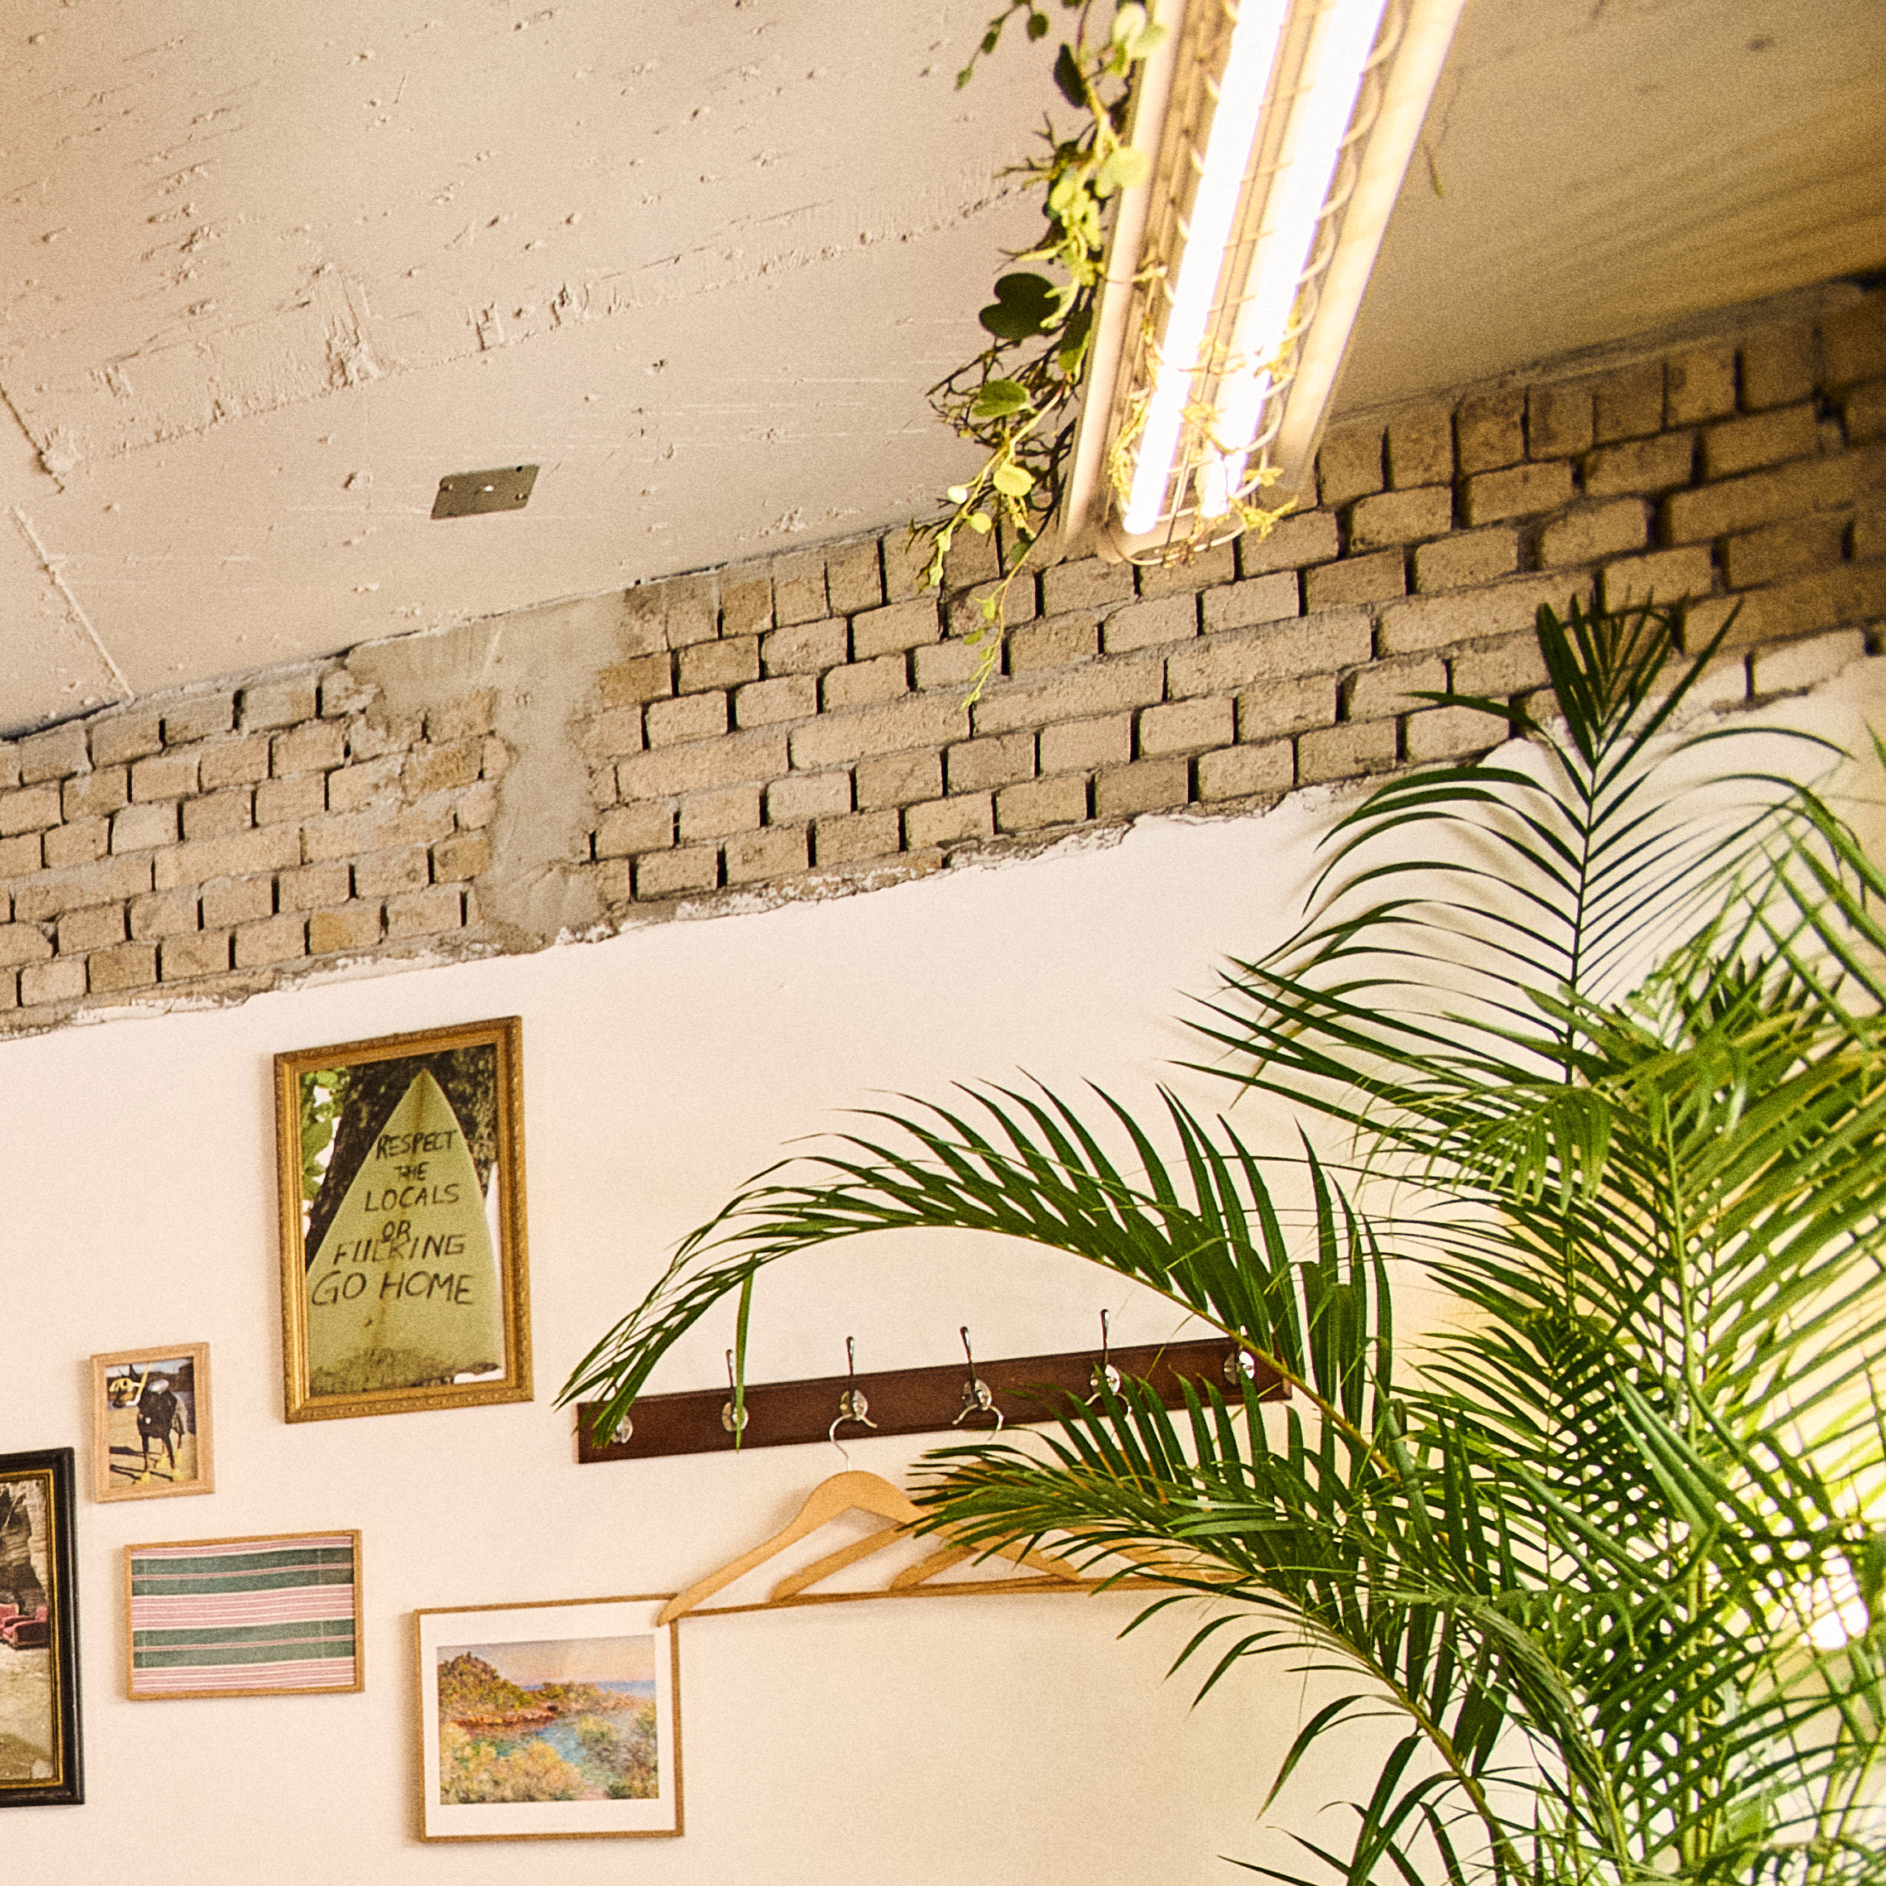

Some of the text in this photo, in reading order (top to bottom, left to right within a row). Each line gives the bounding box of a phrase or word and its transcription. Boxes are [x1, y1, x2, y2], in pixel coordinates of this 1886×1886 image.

[377, 1130, 458, 1161] RESPECT
[394, 1161, 429, 1182] THE
[365, 1184, 460, 1212] LOCALS
[381, 1220, 412, 1243] OR
[333, 1233, 467, 1266] FUCKING
[312, 1270, 475, 1306] GO HOME
